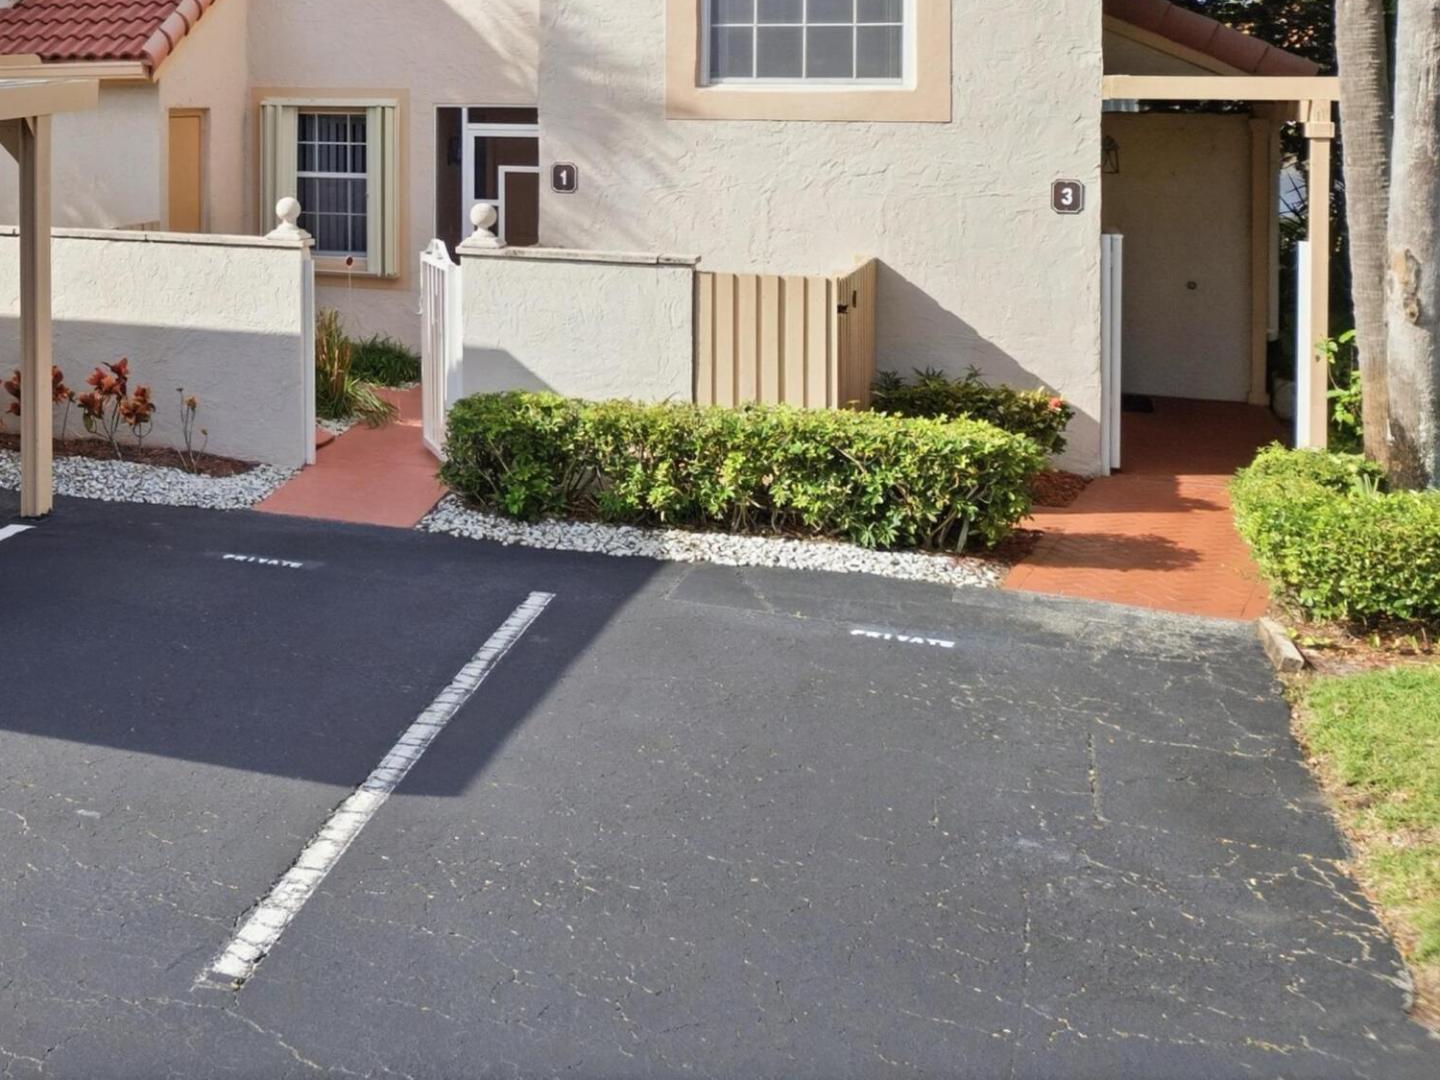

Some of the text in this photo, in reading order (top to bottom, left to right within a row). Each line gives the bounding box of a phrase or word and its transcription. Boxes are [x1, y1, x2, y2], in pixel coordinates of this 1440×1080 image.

[560, 170, 567, 185] 1
[1061, 187, 1073, 205] 3
[222, 553, 303, 568] PRIVATE
[850, 629, 955, 648] PRIVATE
